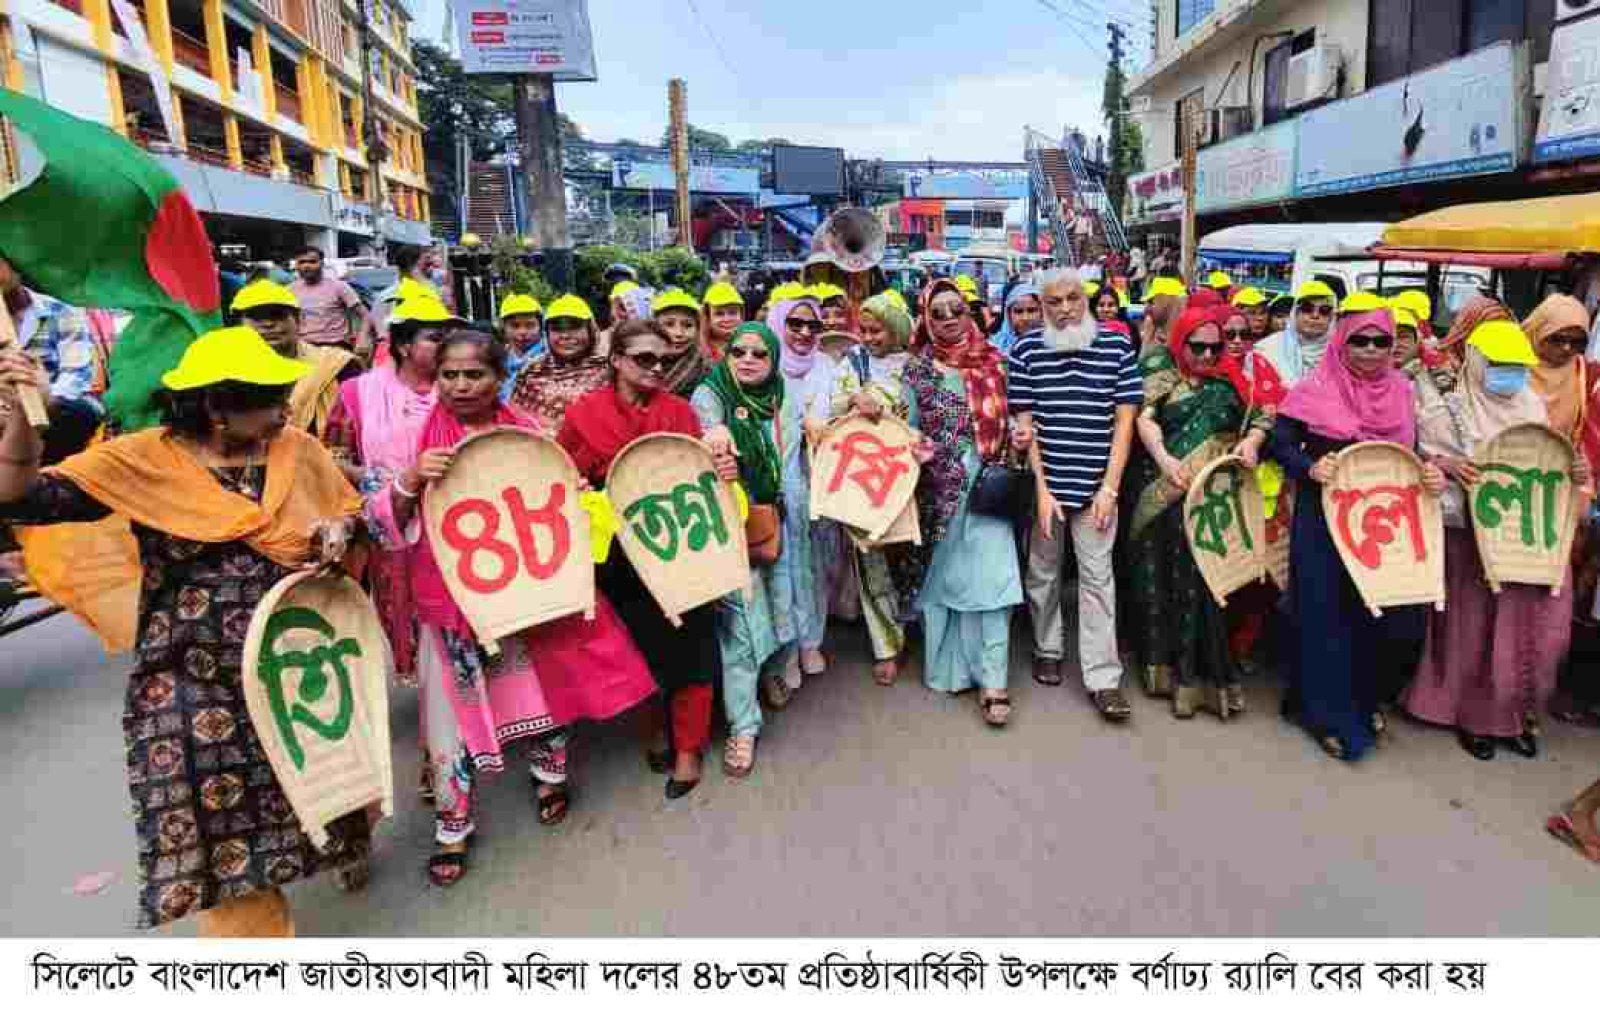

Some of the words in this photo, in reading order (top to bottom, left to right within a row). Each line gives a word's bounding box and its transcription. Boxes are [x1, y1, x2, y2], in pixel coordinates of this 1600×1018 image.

[441, 480, 571, 593] ৪৮
[1332, 484, 1427, 569] লে
[1475, 463, 1563, 550] লা
